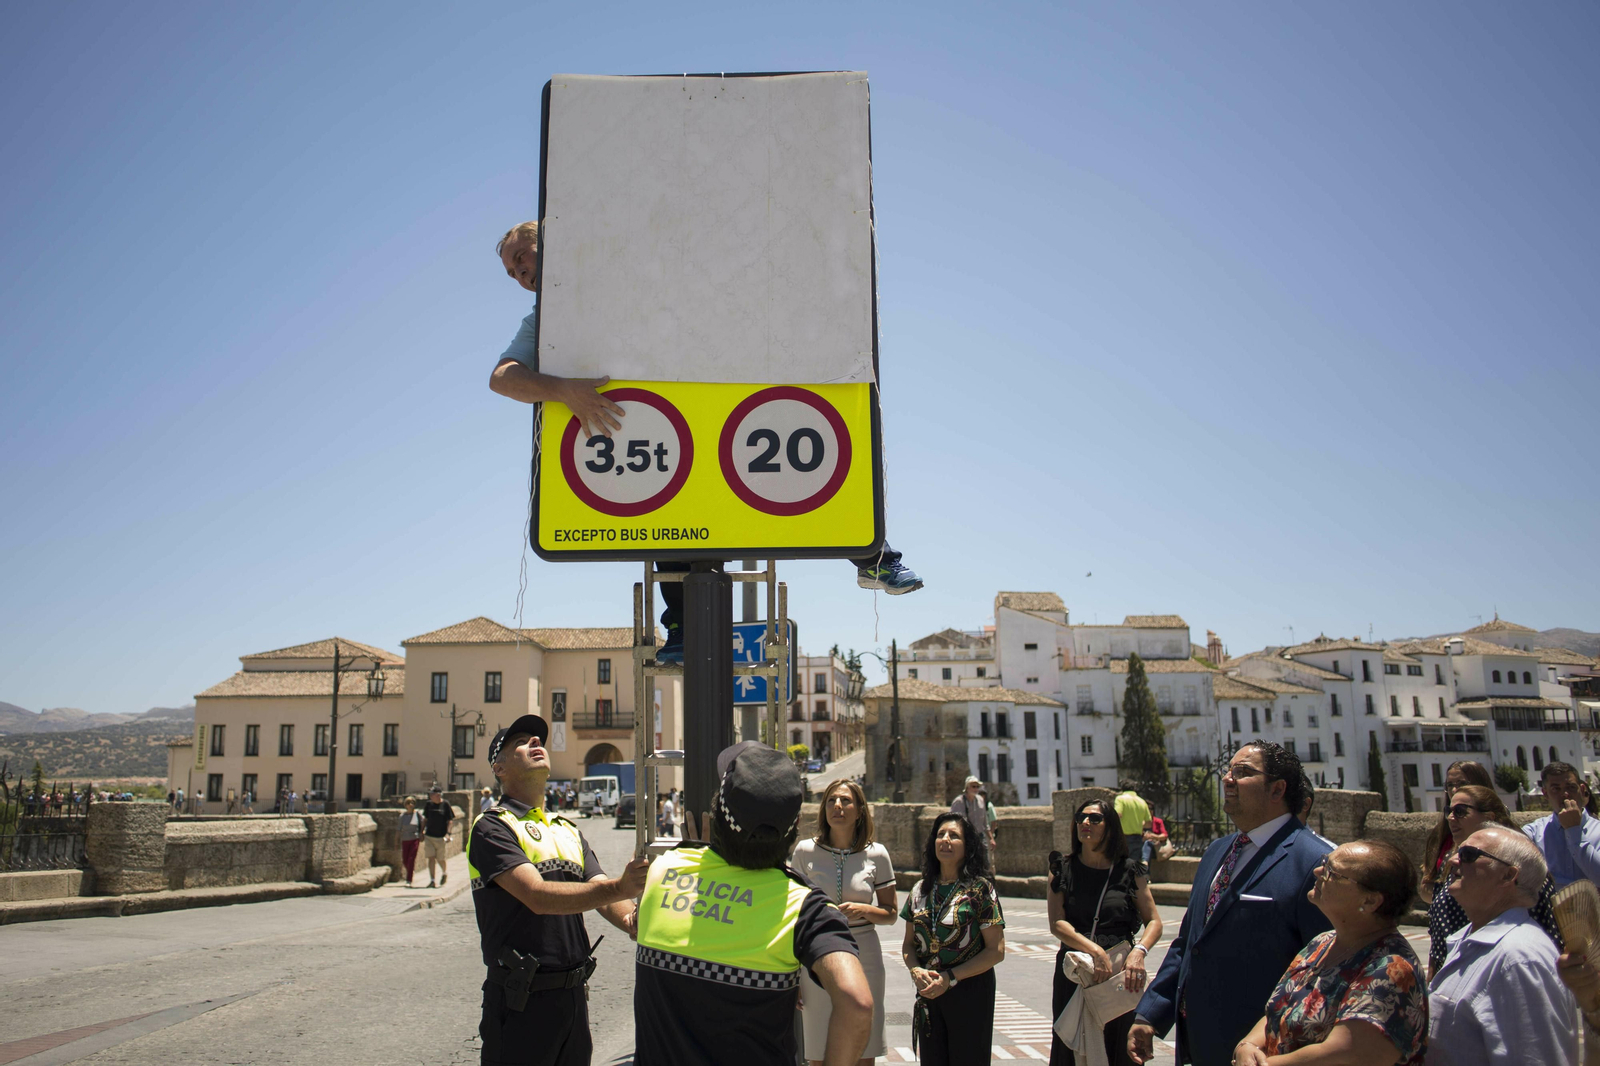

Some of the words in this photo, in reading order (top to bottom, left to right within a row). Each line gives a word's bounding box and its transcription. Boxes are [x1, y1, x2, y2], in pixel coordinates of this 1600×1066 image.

[585, 434, 669, 476] 3,5t
[746, 427, 825, 473] 20
[554, 529, 617, 542] EXCEPTO
[620, 528, 648, 541] BUS
[652, 527, 710, 540] URBANO
[661, 869, 753, 906] POLICIA
[661, 892, 734, 924] LOCAL
